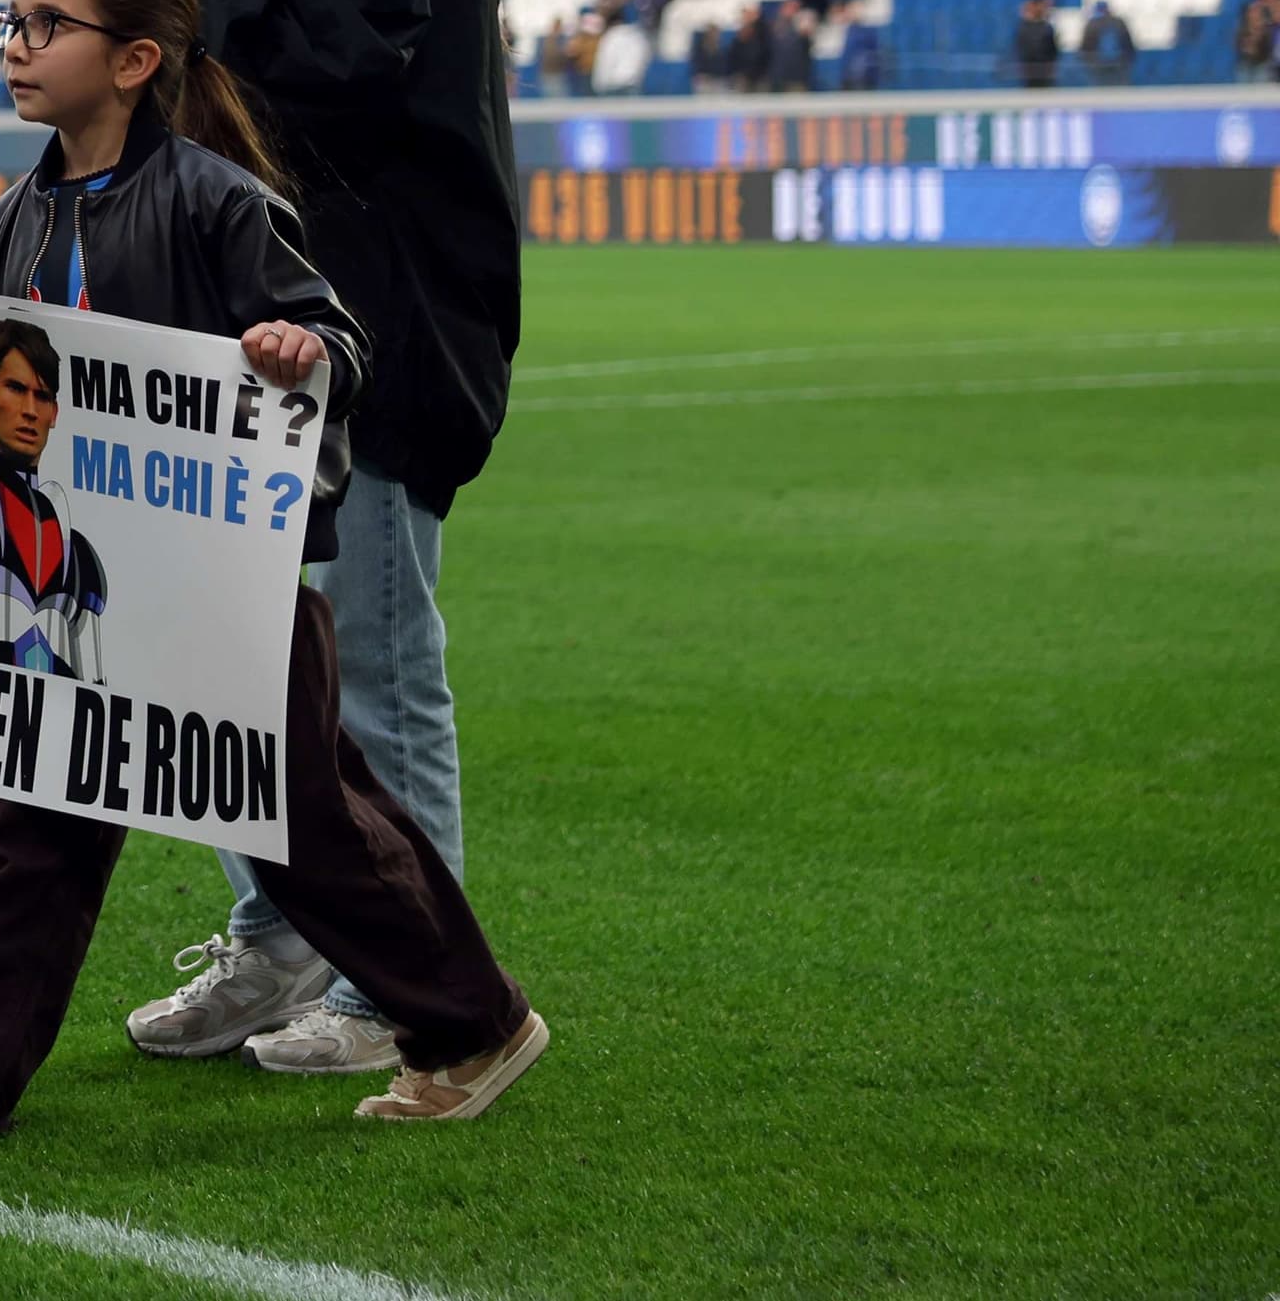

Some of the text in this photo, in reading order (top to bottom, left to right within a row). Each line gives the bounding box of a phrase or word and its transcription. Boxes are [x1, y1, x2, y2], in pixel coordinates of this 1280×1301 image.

[70, 355, 319, 447] MA CHI È ?
[73, 435, 304, 531] MA CHI È ?
[66, 687, 132, 812] DE
[143, 702, 278, 823] ROON
